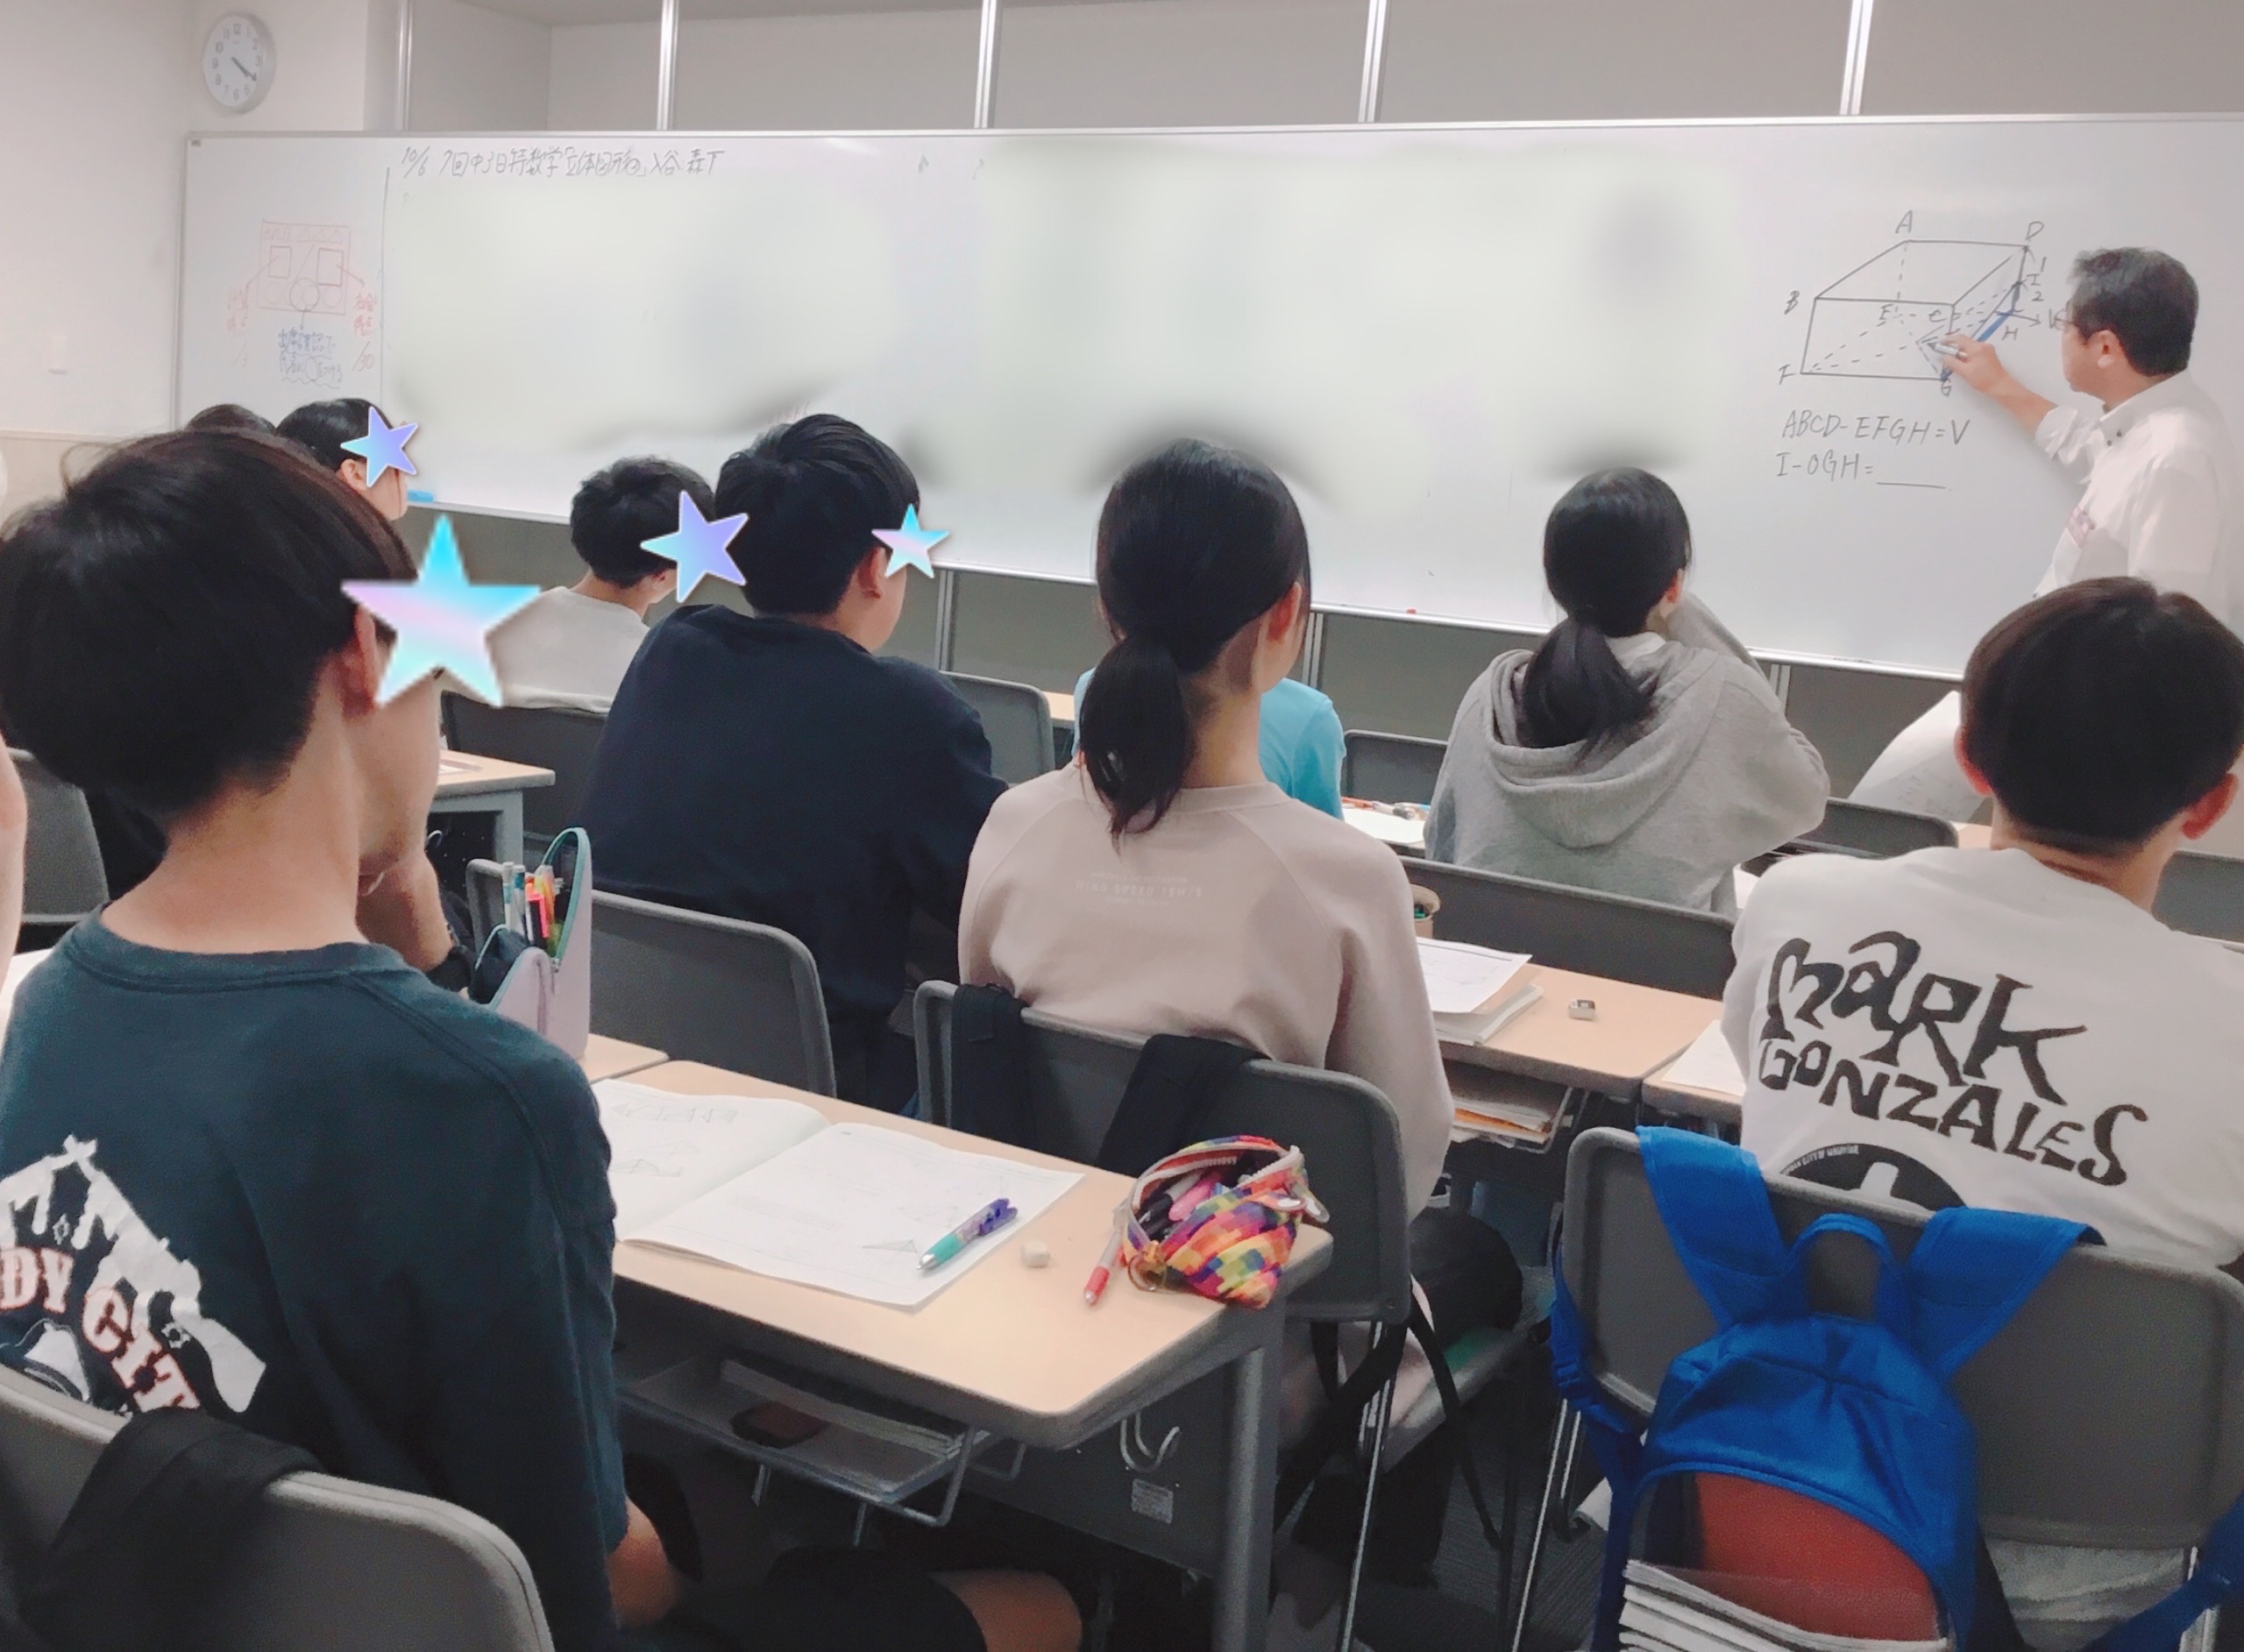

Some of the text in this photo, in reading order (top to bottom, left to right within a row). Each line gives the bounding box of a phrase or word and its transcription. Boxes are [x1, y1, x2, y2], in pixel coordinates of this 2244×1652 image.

[1895, 209, 1914, 234] A
[2025, 221, 2044, 240] D
[1784, 290, 1800, 316] B
[2032, 291, 2044, 301] 2
[2001, 325, 2019, 341] H
